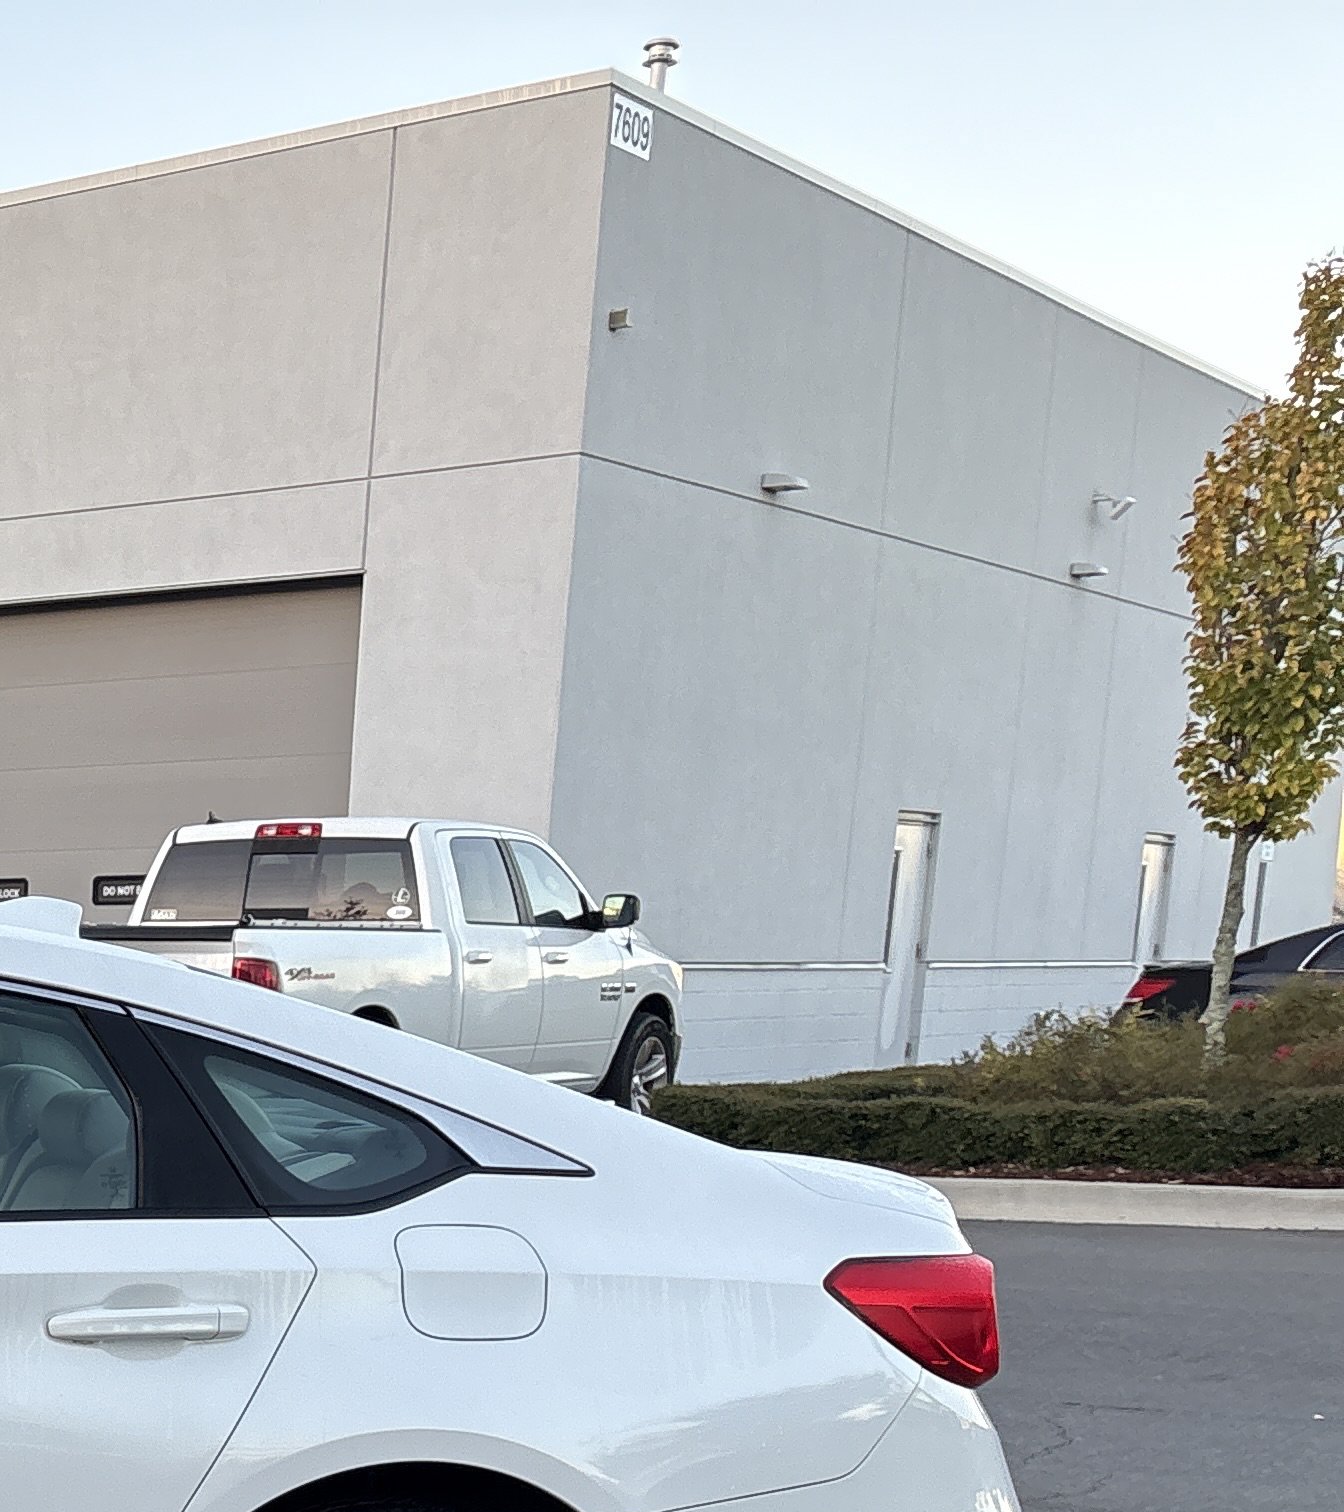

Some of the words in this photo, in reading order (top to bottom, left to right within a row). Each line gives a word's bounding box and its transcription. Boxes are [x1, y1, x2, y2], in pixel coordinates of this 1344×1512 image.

[614, 102, 650, 151] 7609
[102, 886, 116, 896] DO
[117, 885, 135, 896] NOT
